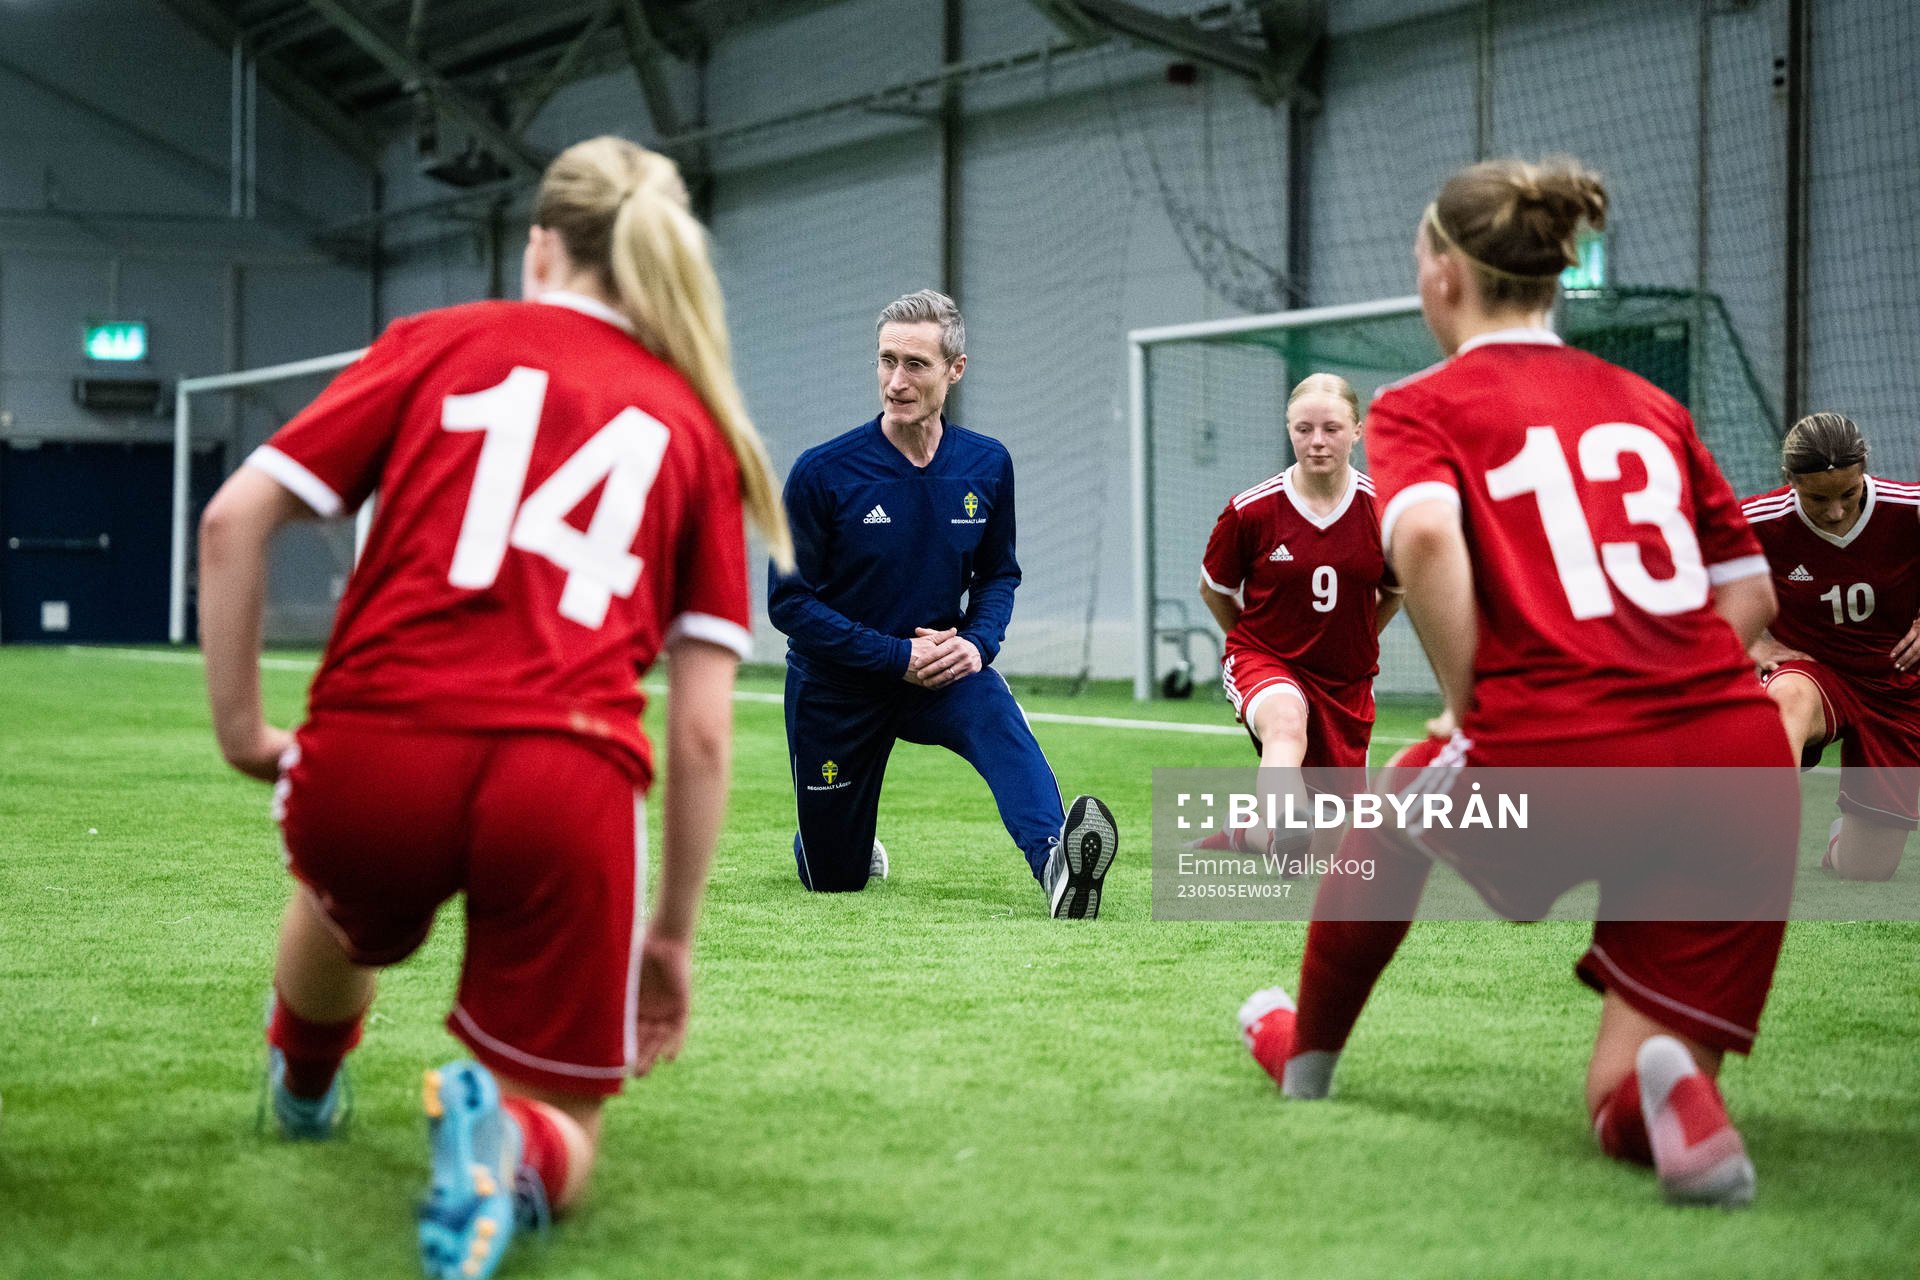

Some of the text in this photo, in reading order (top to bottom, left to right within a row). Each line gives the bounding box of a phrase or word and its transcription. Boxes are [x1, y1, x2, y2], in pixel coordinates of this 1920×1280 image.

[441, 366, 671, 630] 14
[863, 516, 891, 524] adidas
[1486, 422, 1712, 620] 13
[1269, 554, 1294, 562] adidas
[1788, 574, 1814, 582] adidas
[1312, 565, 1338, 613] 9
[1820, 582, 1875, 625] 10
